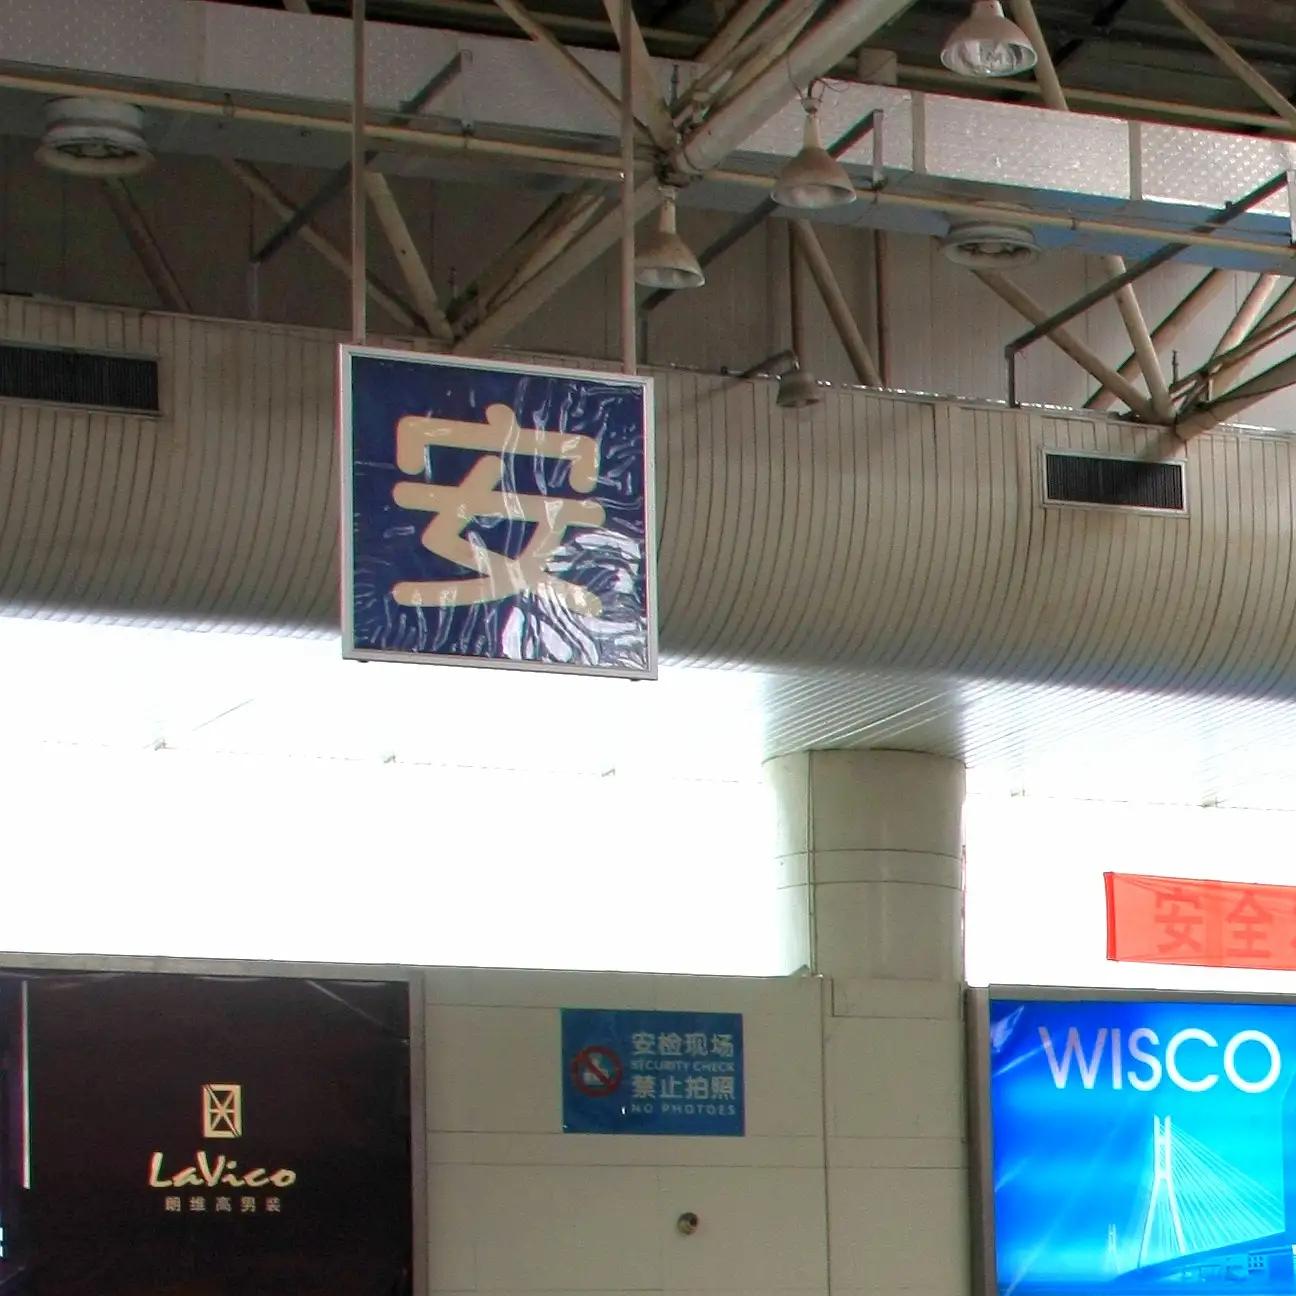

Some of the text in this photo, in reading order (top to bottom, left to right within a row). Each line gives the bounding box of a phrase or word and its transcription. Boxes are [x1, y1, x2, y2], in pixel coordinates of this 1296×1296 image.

[391, 402, 606, 617] 安
[631, 1031, 735, 1058] 安检现场
[1039, 1027, 1282, 1094] WISCO
[692, 1061, 735, 1073] CHECK
[631, 1075, 736, 1101] 禁止拍照
[148, 1151, 297, 1188] LaVico
